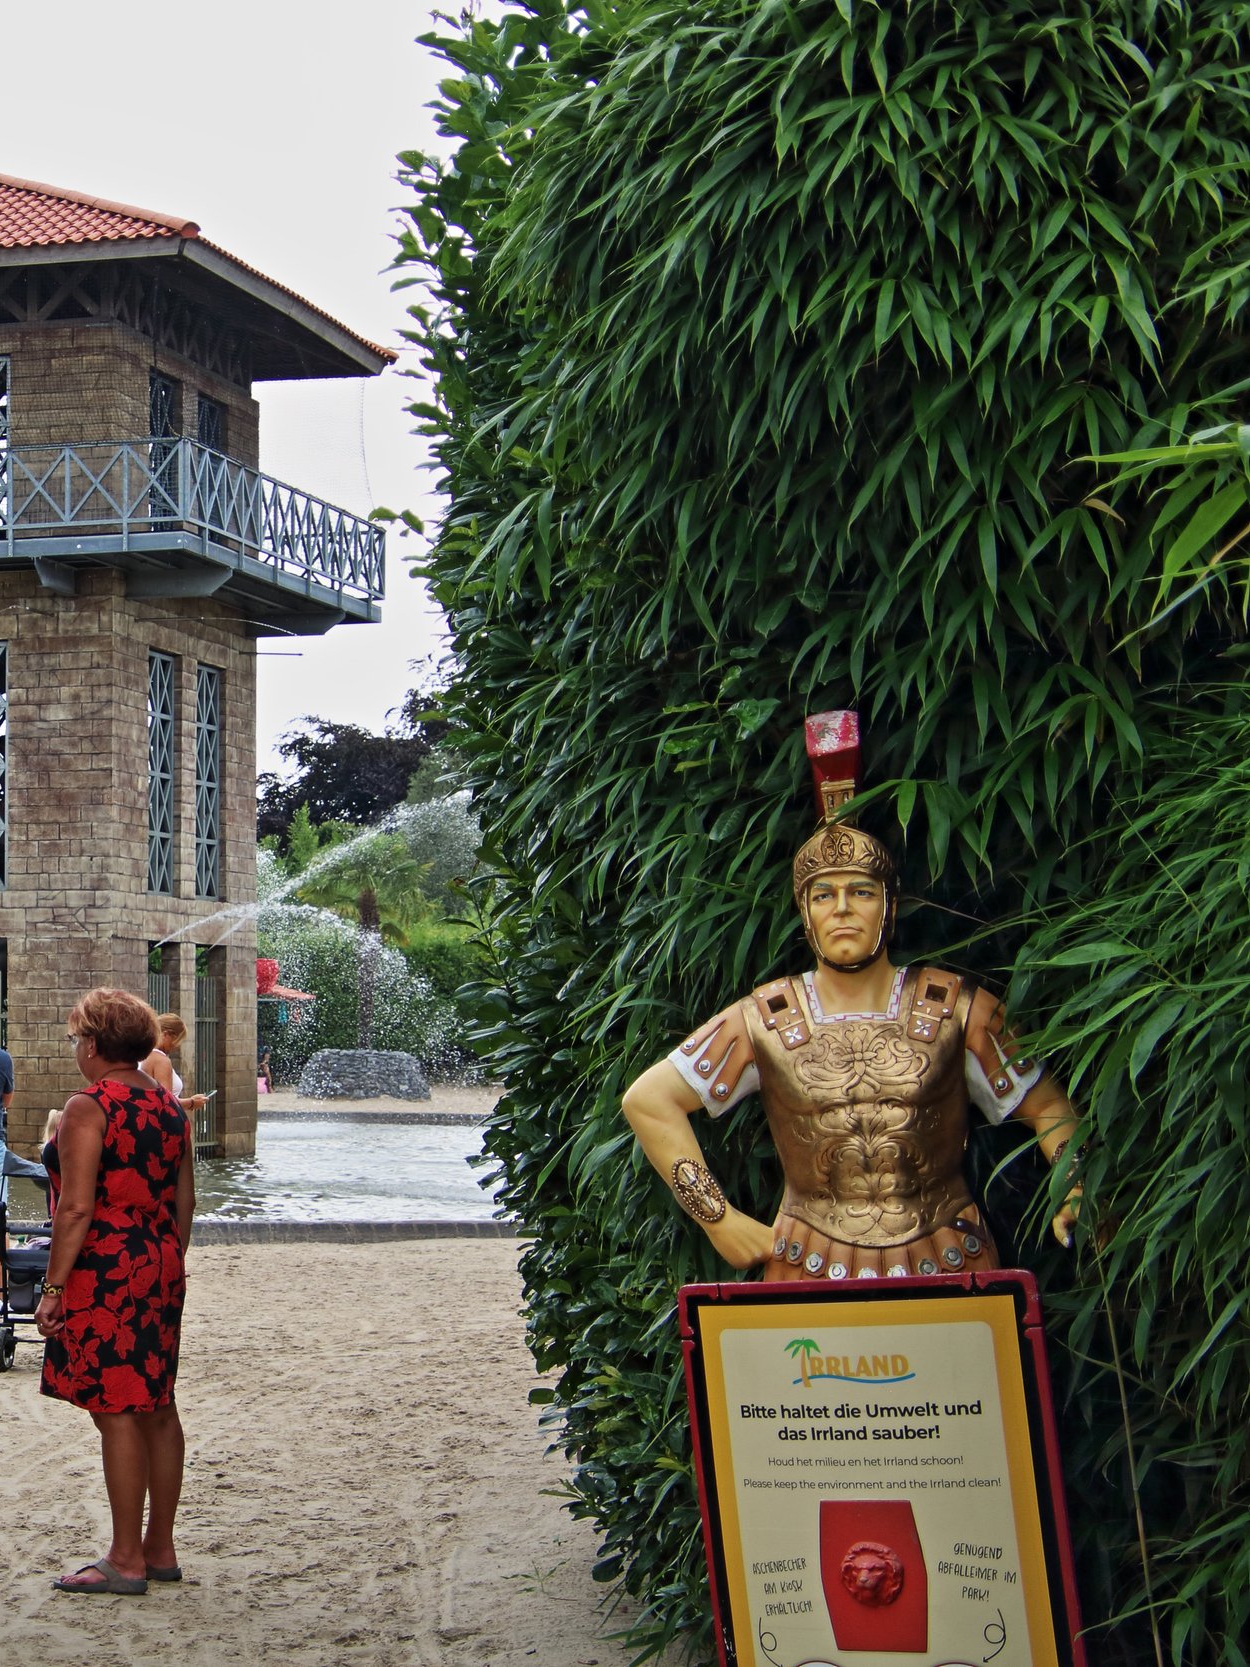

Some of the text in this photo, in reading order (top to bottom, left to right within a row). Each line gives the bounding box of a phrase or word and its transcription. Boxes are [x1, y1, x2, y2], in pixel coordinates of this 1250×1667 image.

[740, 1400, 982, 1419] Bitte haltet die Umwelt und
[778, 1425, 940, 1441] das Irrland sauber!
[768, 1456, 964, 1467] Houd het milieu en het Irrland schoon!
[743, 1477, 1001, 1491] Please keep the environment and the Irrland clean!
[752, 1557, 807, 1575] ASCHENBECHER
[763, 1582, 777, 1595] AM
